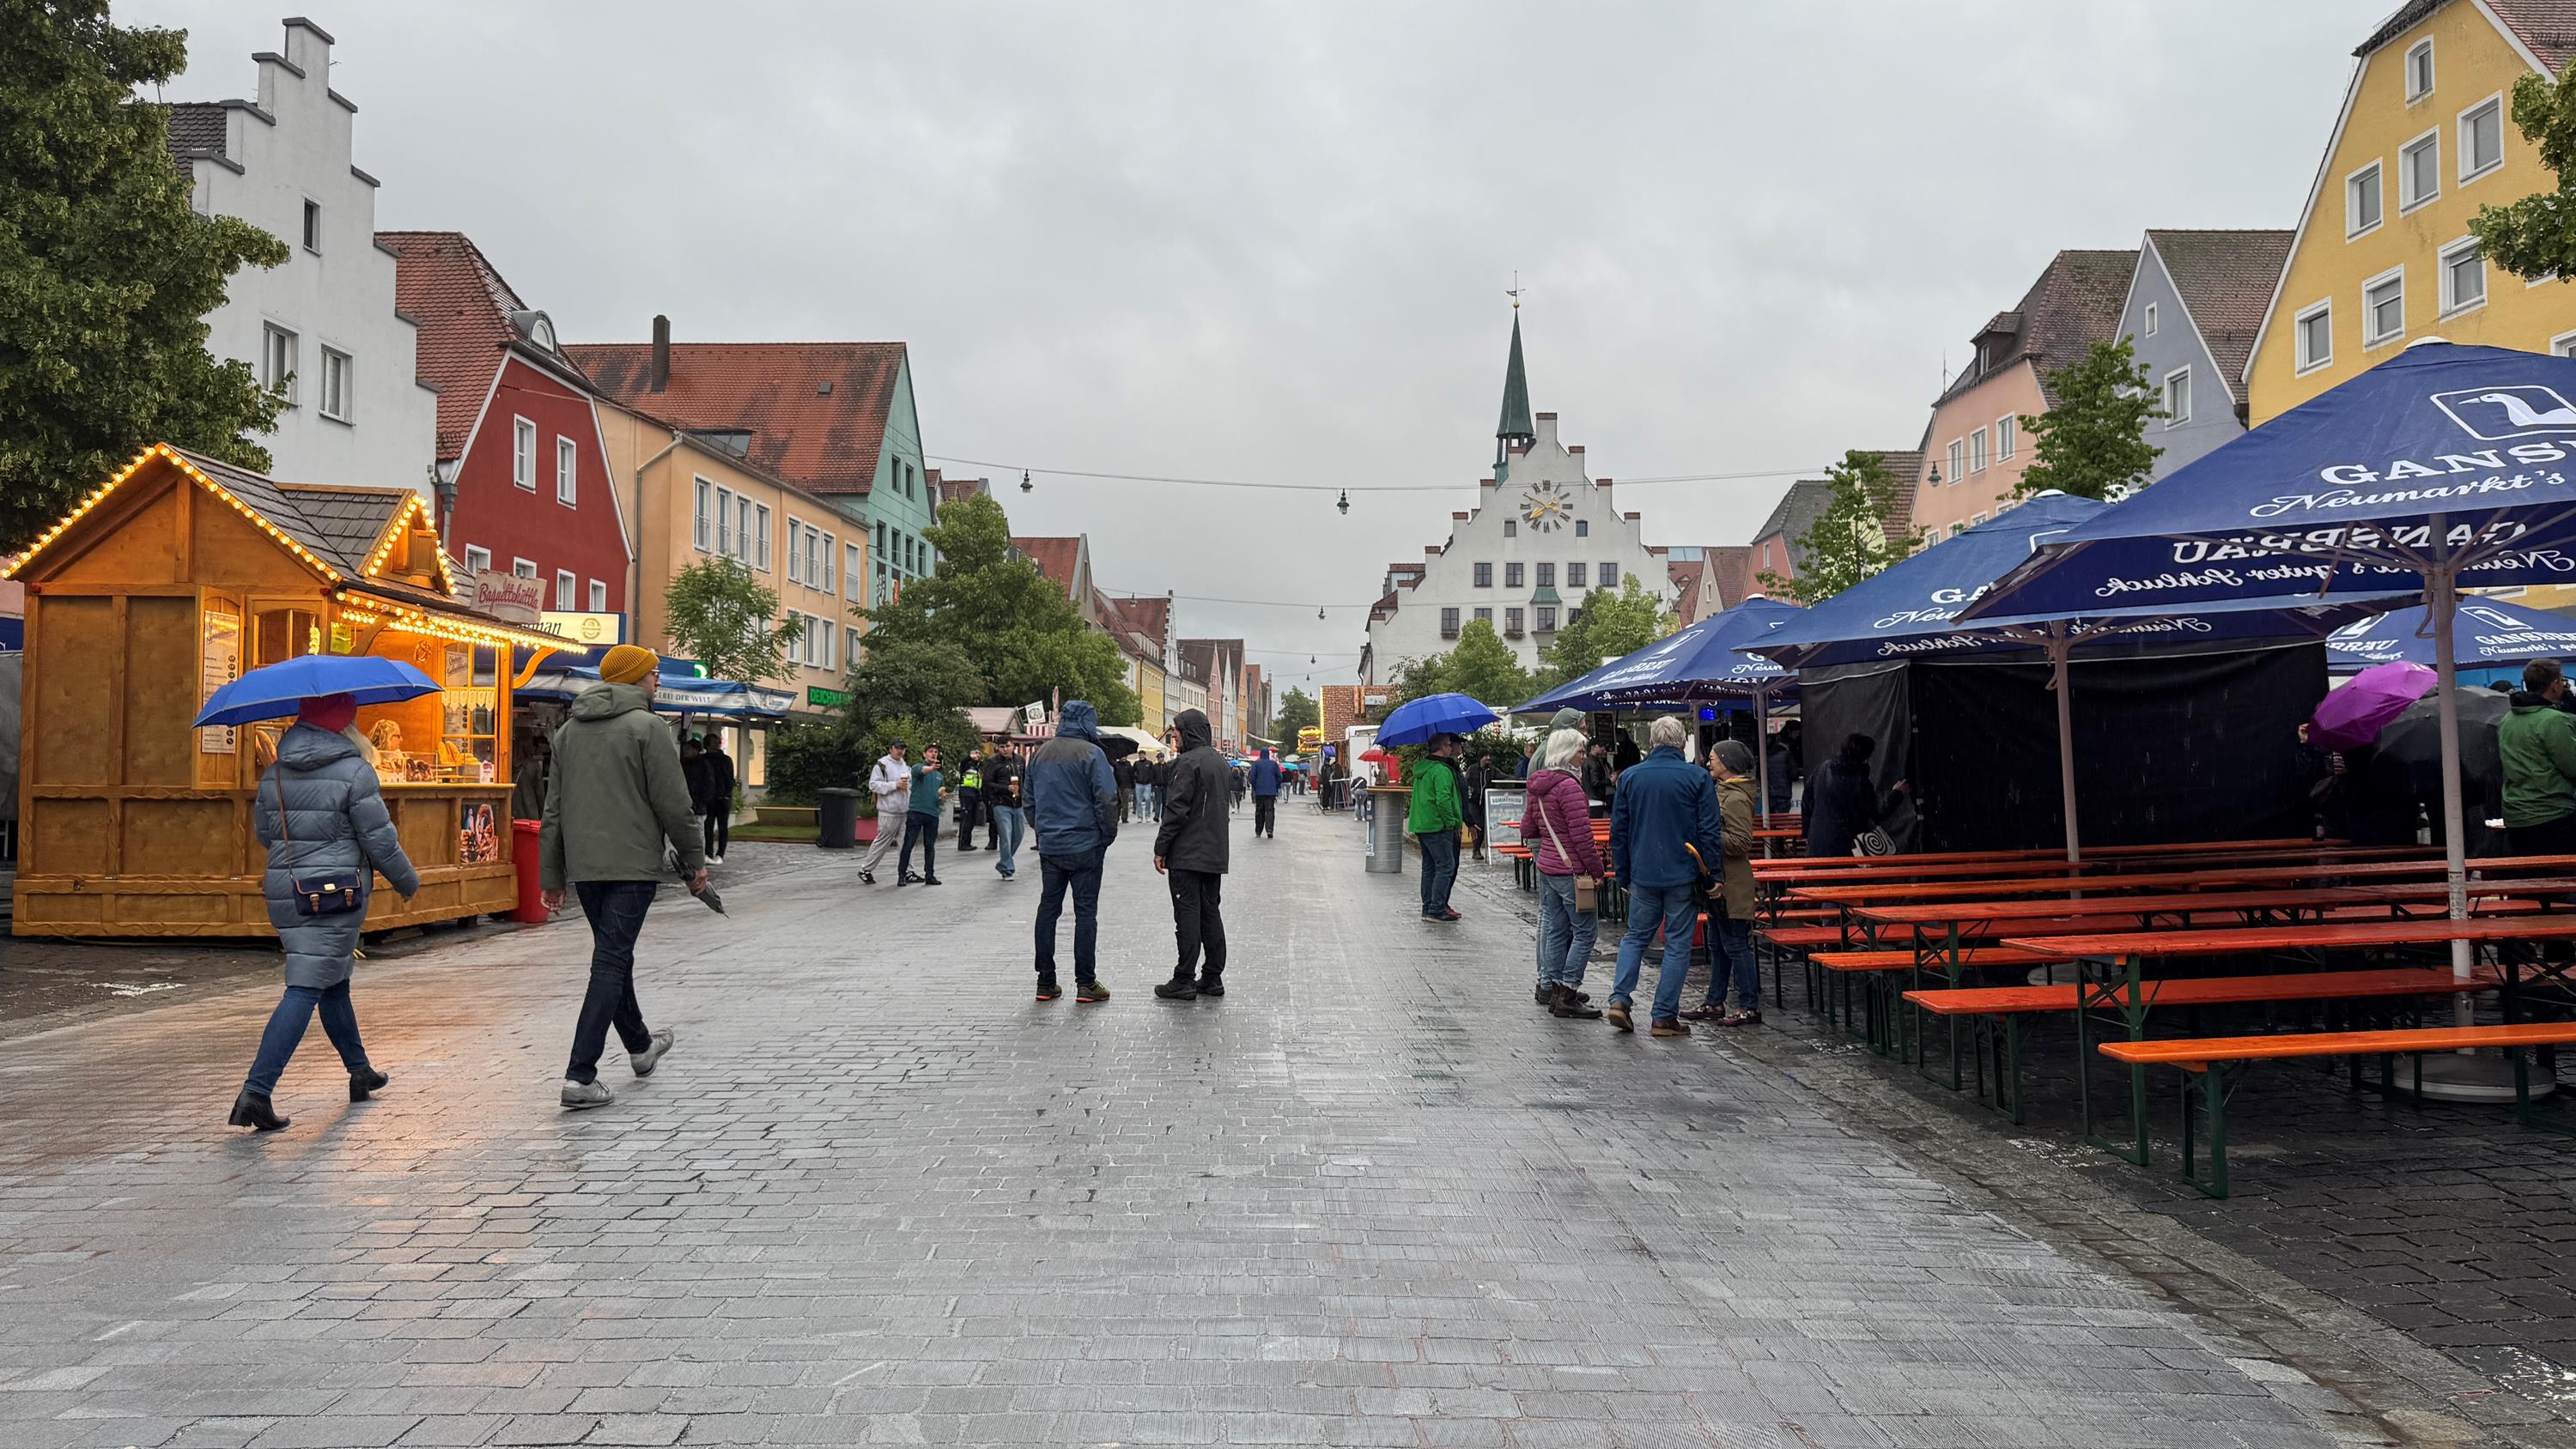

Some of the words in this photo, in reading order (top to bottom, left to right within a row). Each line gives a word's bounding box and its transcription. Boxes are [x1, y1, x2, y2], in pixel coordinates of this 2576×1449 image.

[2321, 440, 2576, 485] GANS
[2250, 470, 2566, 517] Neumarkt's
[2325, 639, 2399, 652] BRÄU
